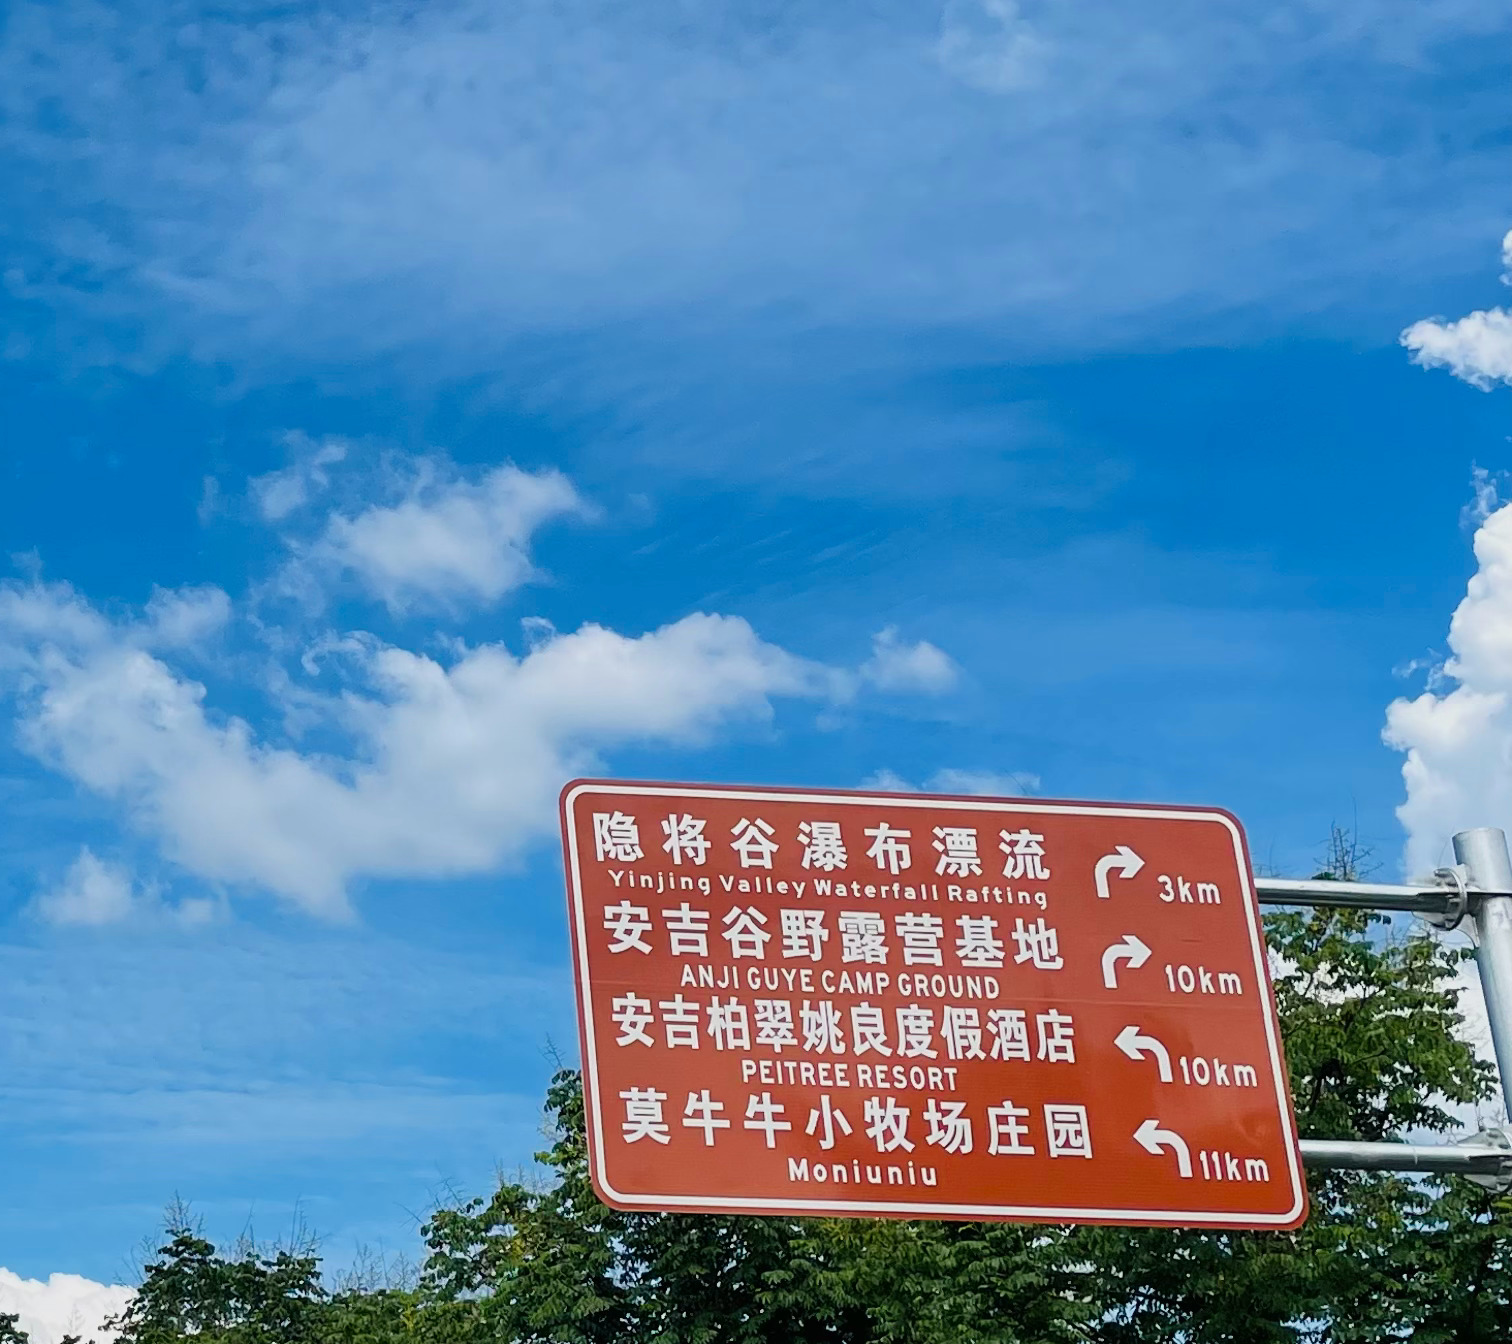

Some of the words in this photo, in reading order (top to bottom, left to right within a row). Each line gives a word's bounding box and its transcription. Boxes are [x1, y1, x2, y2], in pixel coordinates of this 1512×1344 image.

[592, 810, 1051, 880] 隐将谷瀑布漂流
[607, 869, 711, 896] Yinjing
[718, 874, 806, 899] Valley
[813, 878, 939, 901] Waterfall
[947, 884, 1047, 910] Rafting
[1157, 874, 1221, 905] 3km
[603, 899, 1064, 970] 安吉谷野露营基地
[680, 963, 740, 989] ANJI
[747, 966, 815, 993] GUYE
[821, 969, 890, 995] CAMP
[897, 972, 1000, 999] GROUND
[1165, 964, 1243, 995] 10km
[611, 991, 1075, 1064] 安吉柏翠姚良度假酒店
[741, 1059, 851, 1088] PEITREE
[856, 1063, 958, 1091] RESORT
[1179, 1056, 1258, 1088] 10km
[618, 1086, 1093, 1159] 莫牛牛小牧场庄园
[787, 1157, 937, 1186] Moniuniu
[1199, 1150, 1270, 1182] 11km
